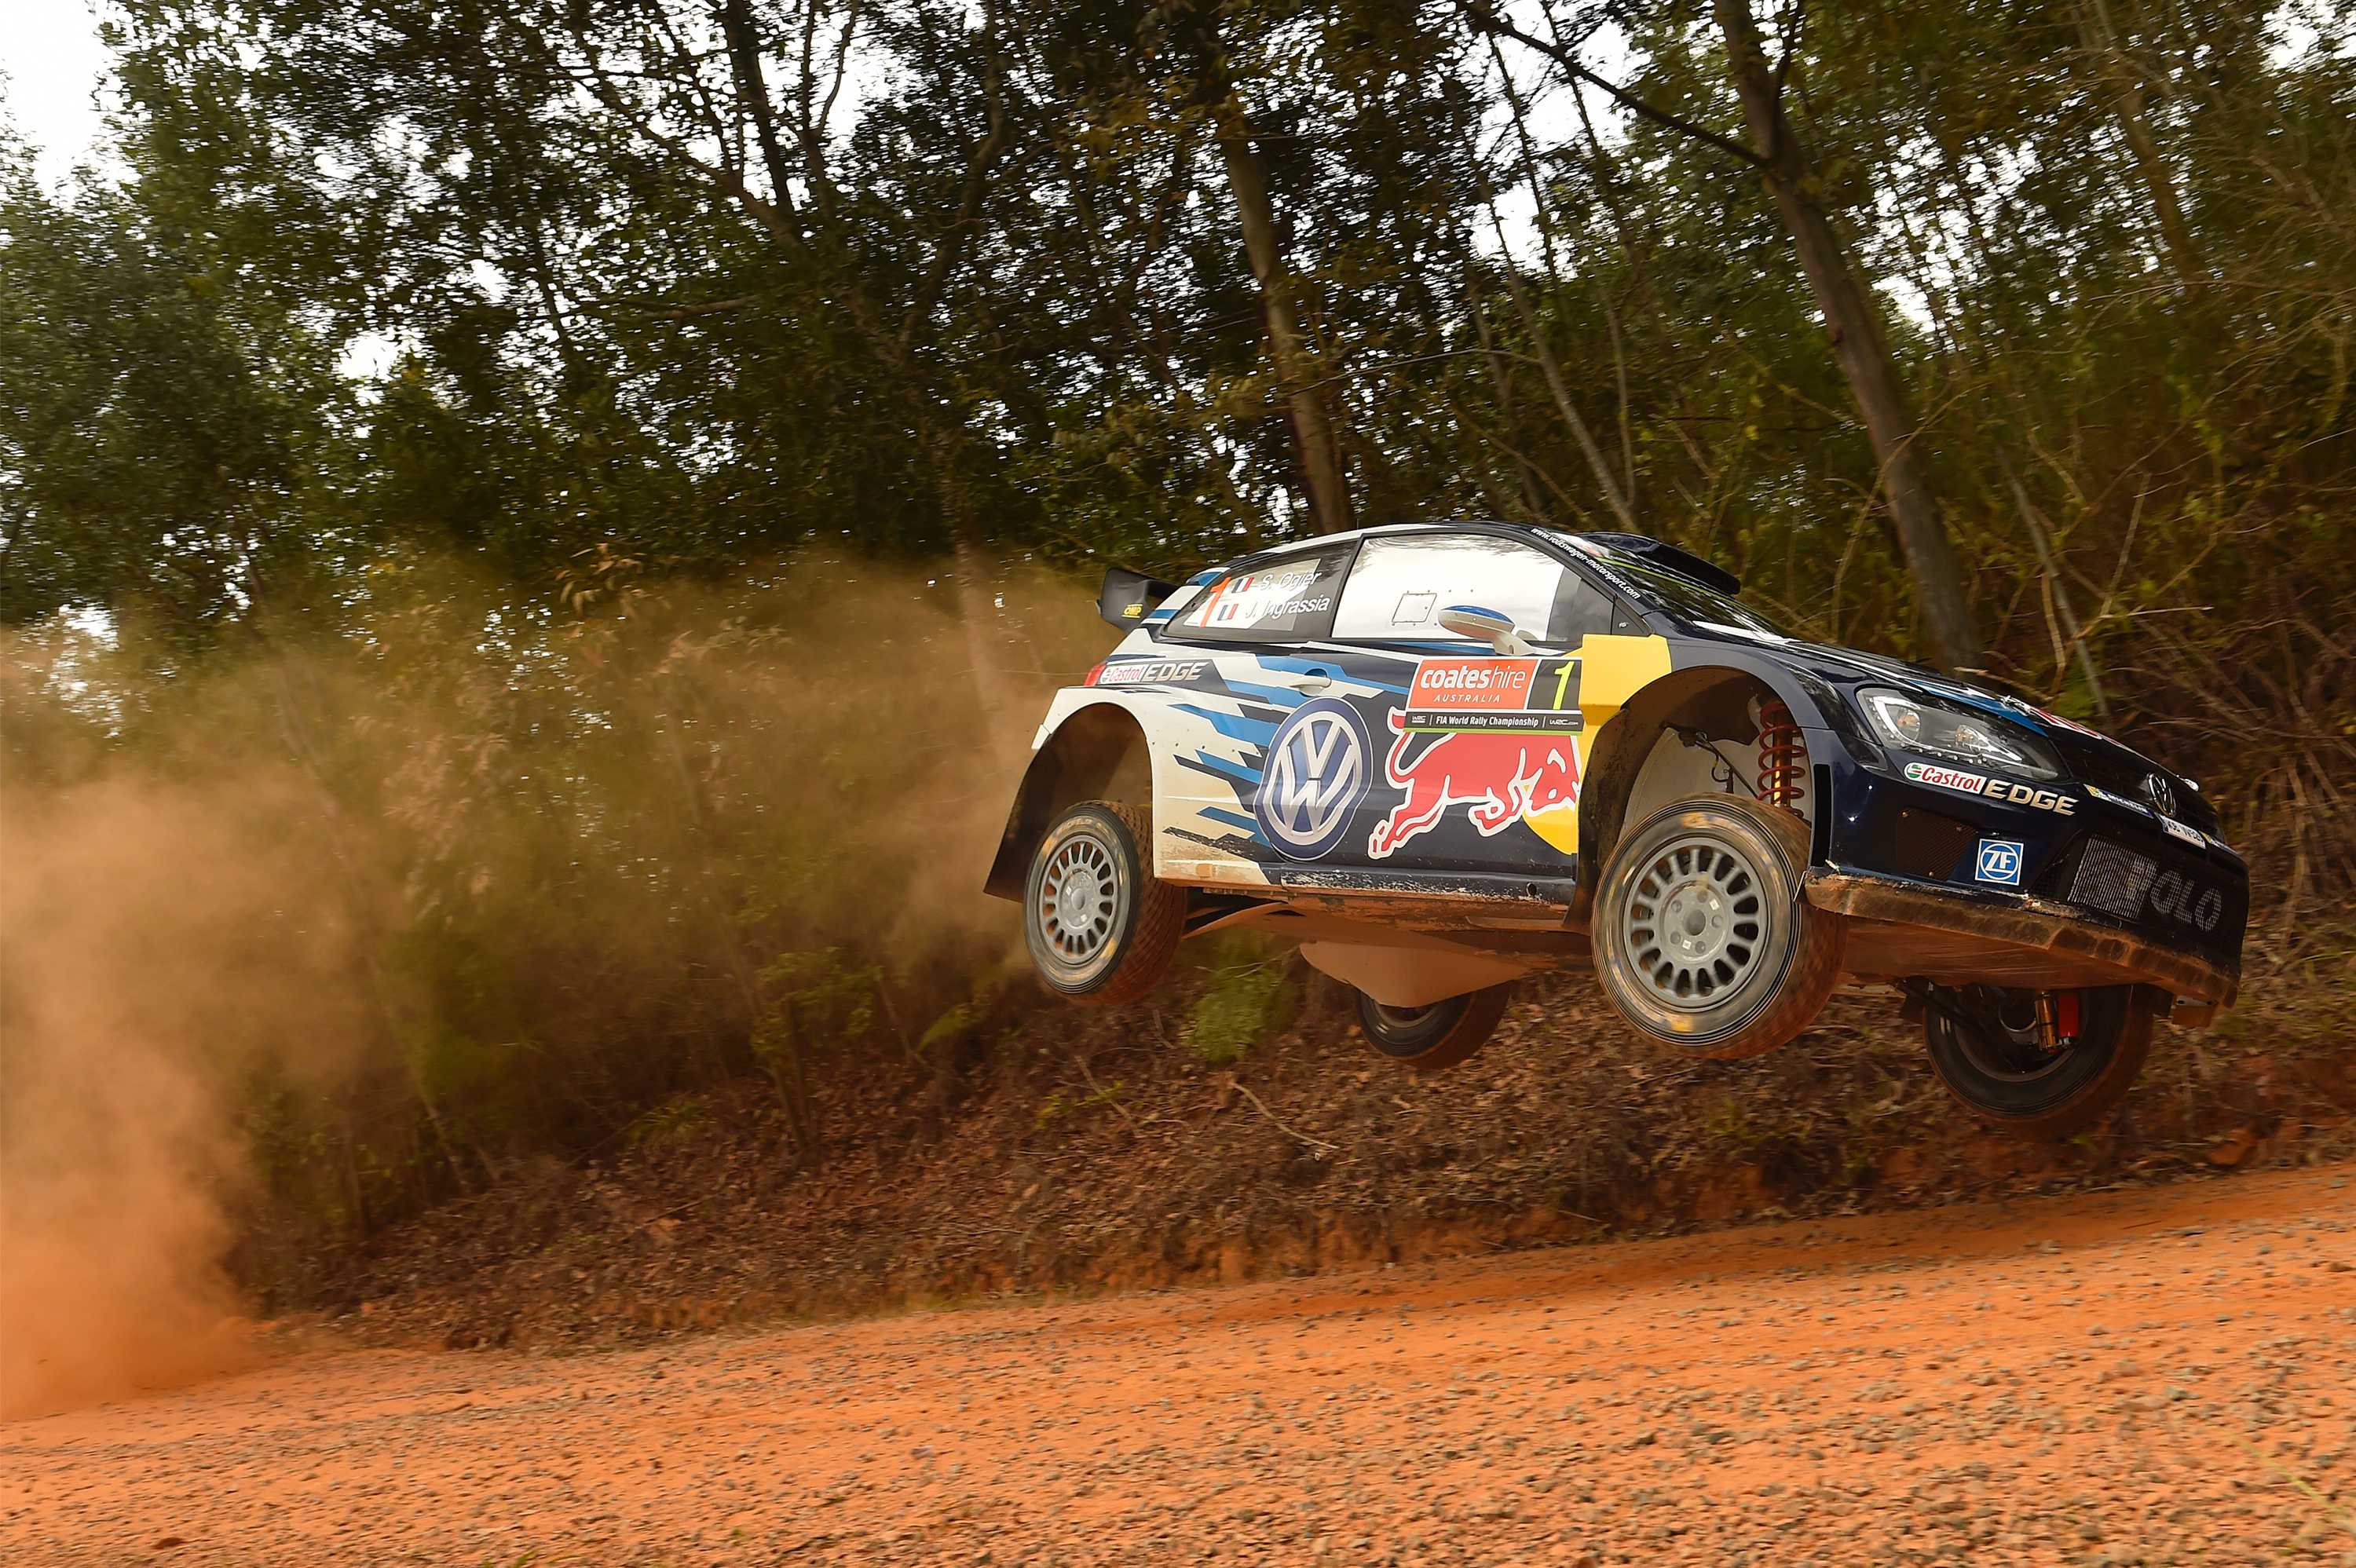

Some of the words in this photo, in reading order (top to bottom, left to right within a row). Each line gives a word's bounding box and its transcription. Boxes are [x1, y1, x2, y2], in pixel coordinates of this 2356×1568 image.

[1531, 527, 1641, 599] www.volkswagen-motorsport.com
[1279, 572, 1323, 590] Ogier
[1123, 606, 1142, 616] OMP
[1210, 576, 1231, 627] 1
[1263, 594, 1330, 620] Ingrassia
[1109, 667, 1144, 682] Castrol
[1141, 663, 1209, 682] EDGE
[1553, 660, 1575, 710] 1
[1433, 693, 1501, 703] AUSTRALIA
[1436, 715, 1447, 724] FIA
[1449, 716, 1469, 725] World
[1470, 716, 1487, 726] Rally
[1489, 716, 1539, 728] Championship
[1922, 767, 1981, 791] Castrol
[1982, 779, 2080, 816] EDGE
[1985, 850, 2017, 874] ZF
